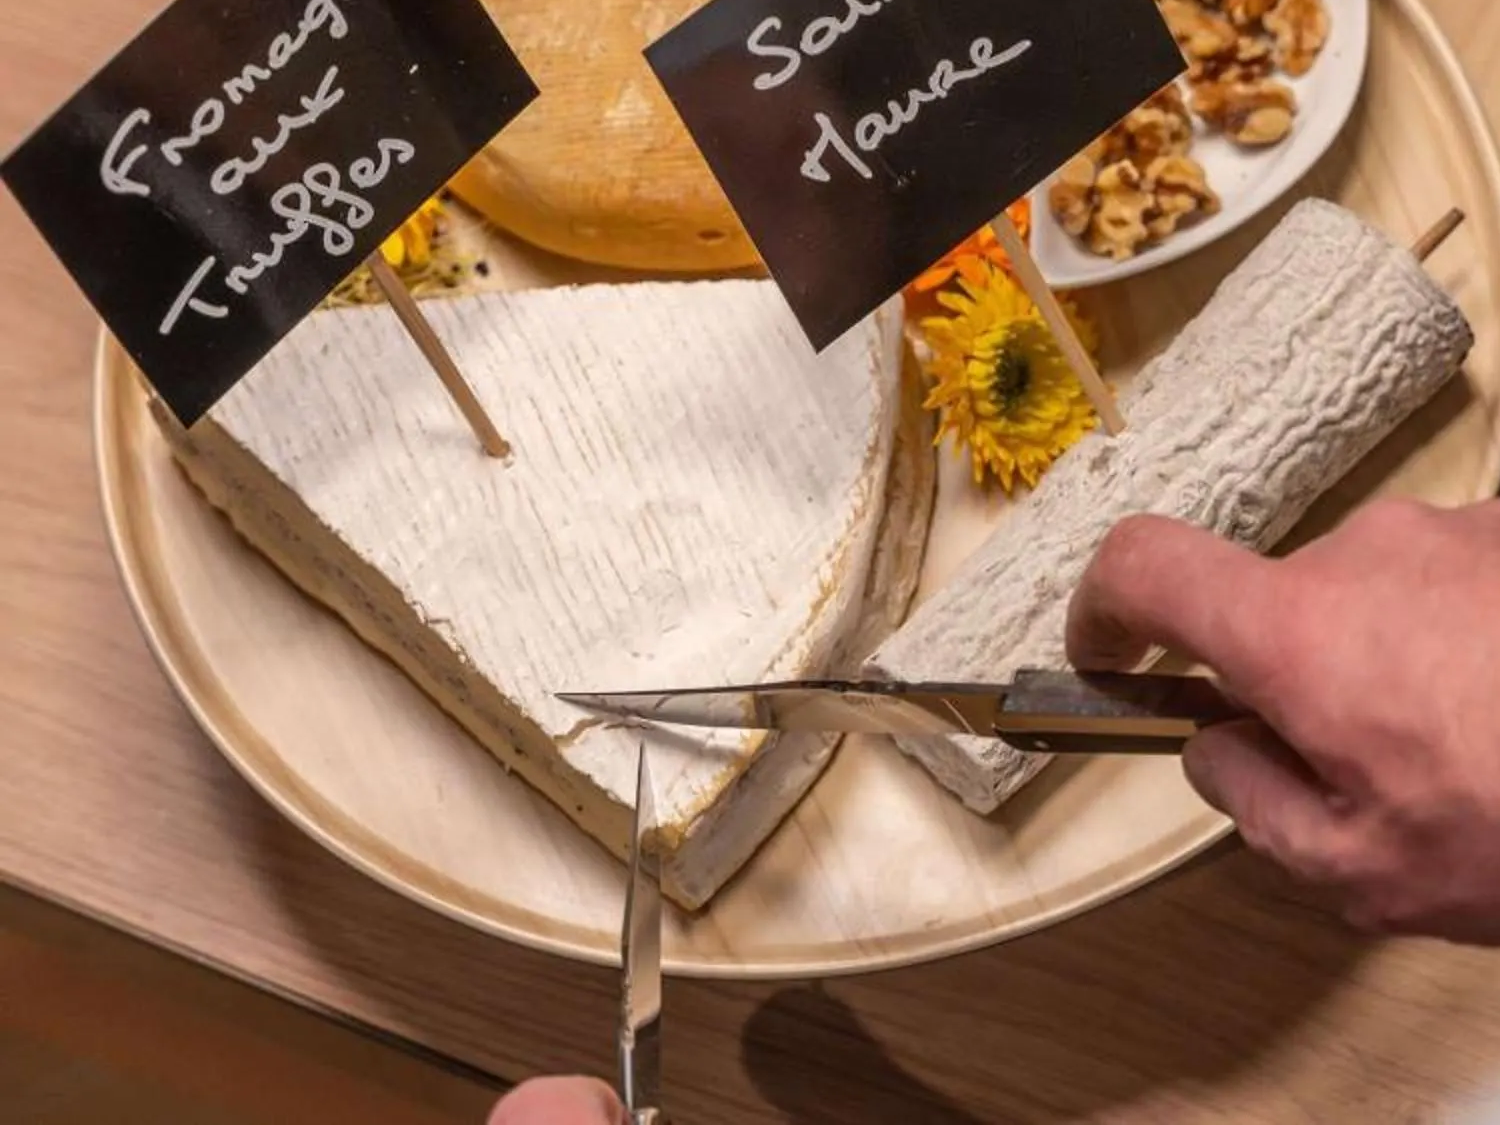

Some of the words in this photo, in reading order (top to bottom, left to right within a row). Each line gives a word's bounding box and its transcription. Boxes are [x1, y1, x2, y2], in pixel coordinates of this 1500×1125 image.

[209, 65, 345, 195] aux
[799, 37, 1032, 183] Maure
[159, 138, 415, 335] Truffes
